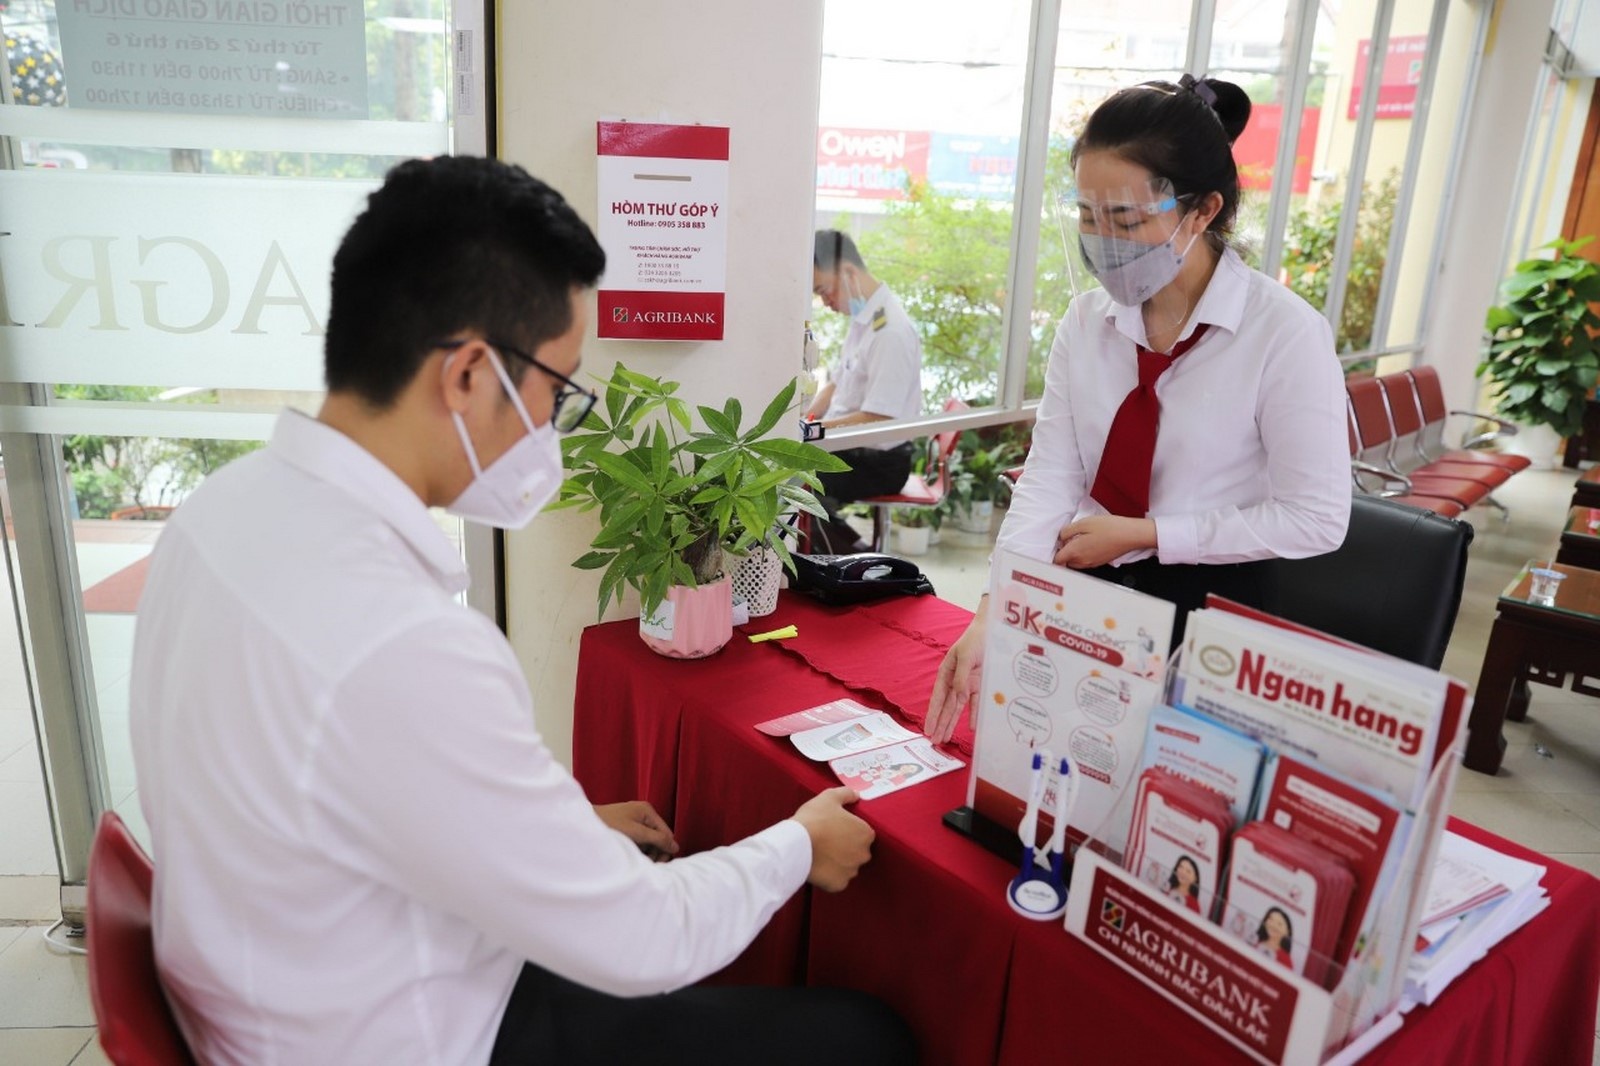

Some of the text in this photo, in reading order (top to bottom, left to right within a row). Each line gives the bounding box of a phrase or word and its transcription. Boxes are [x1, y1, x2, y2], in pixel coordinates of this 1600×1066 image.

[612, 200, 719, 218] HÒM THƯ GÓP Ý
[627, 219, 656, 228] Hotline:
[657, 220, 676, 228] 0905
[677, 221, 691, 229] 358
[633, 311, 716, 324] AGRIBANK
[1006, 600, 1042, 635] 5K
[1058, 633, 1108, 660] COVID-19
[1098, 926, 1121, 946] CHI
[1125, 920, 1270, 1028] AGRIBANK
